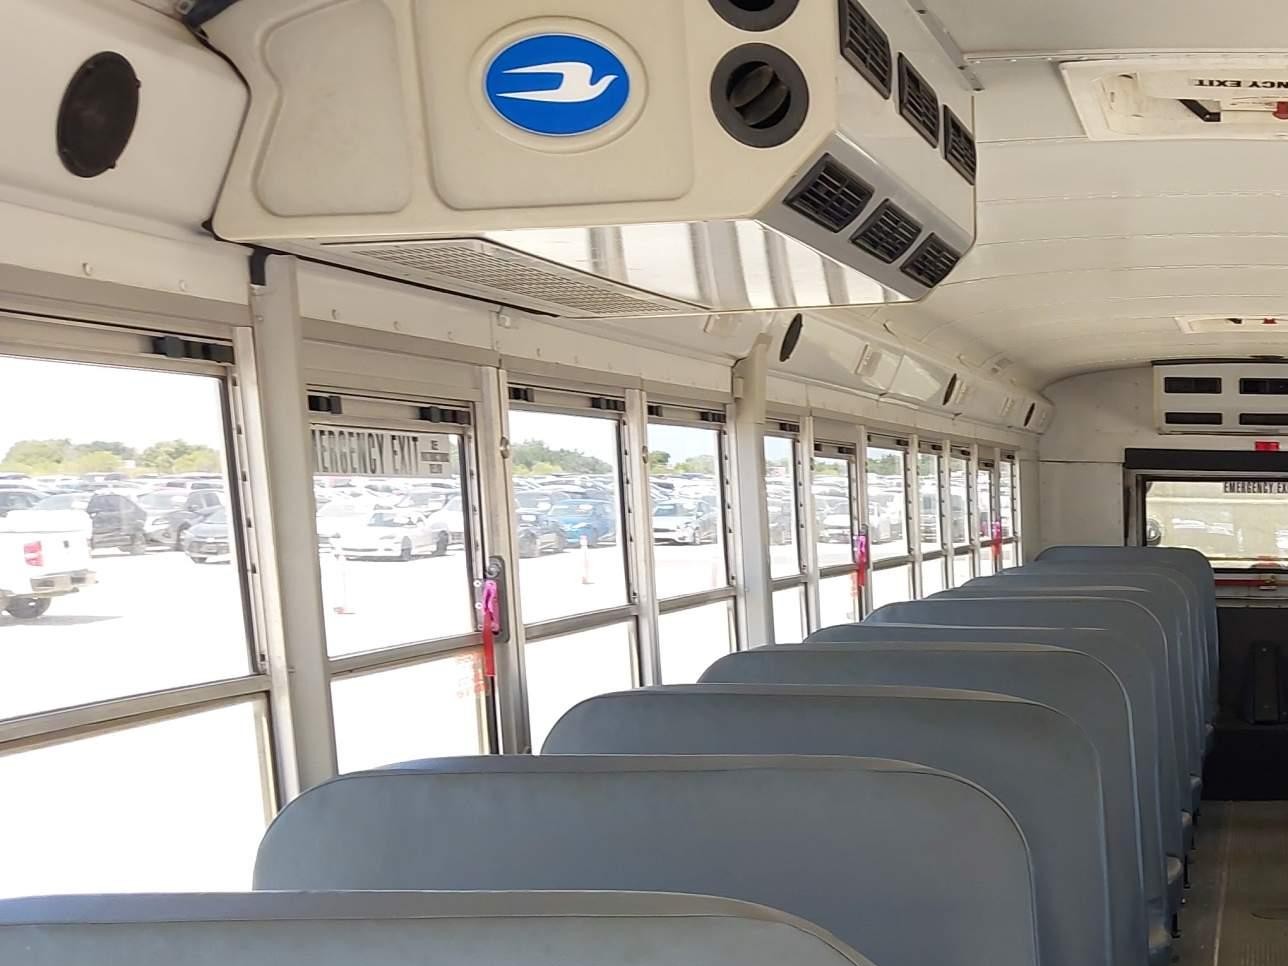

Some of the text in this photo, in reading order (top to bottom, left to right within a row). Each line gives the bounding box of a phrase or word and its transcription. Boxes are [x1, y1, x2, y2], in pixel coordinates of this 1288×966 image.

[1196, 79, 1241, 87] EXIT
[391, 435, 418, 474] EXIT
[1224, 481, 1273, 493] EMERGENCY
